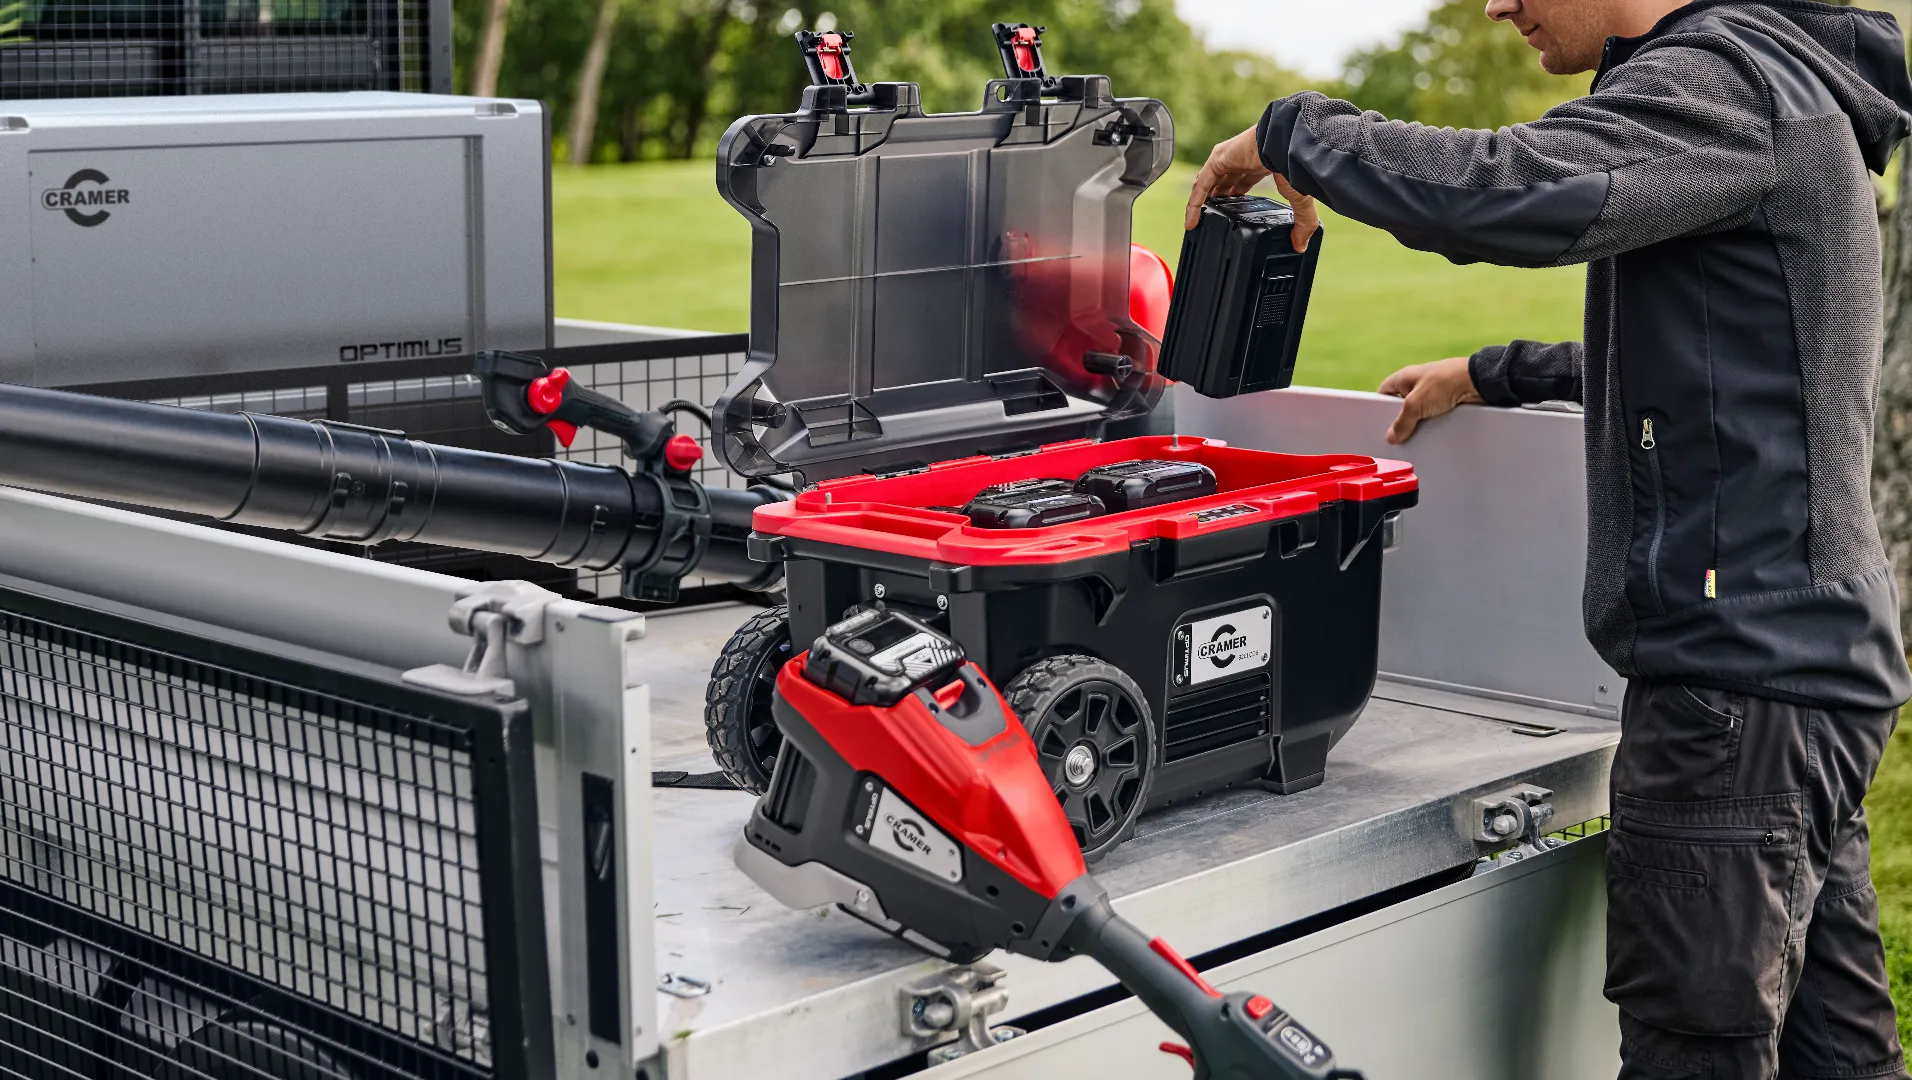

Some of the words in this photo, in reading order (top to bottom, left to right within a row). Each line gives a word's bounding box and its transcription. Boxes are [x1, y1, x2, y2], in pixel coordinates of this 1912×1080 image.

[45, 189, 130, 207] CRAMER
[340, 337, 462, 362] OPTIMUS
[1200, 635, 1247, 657] CRAMER
[864, 792, 878, 829] OPTIMUS
[886, 815, 932, 855] CRAMER
